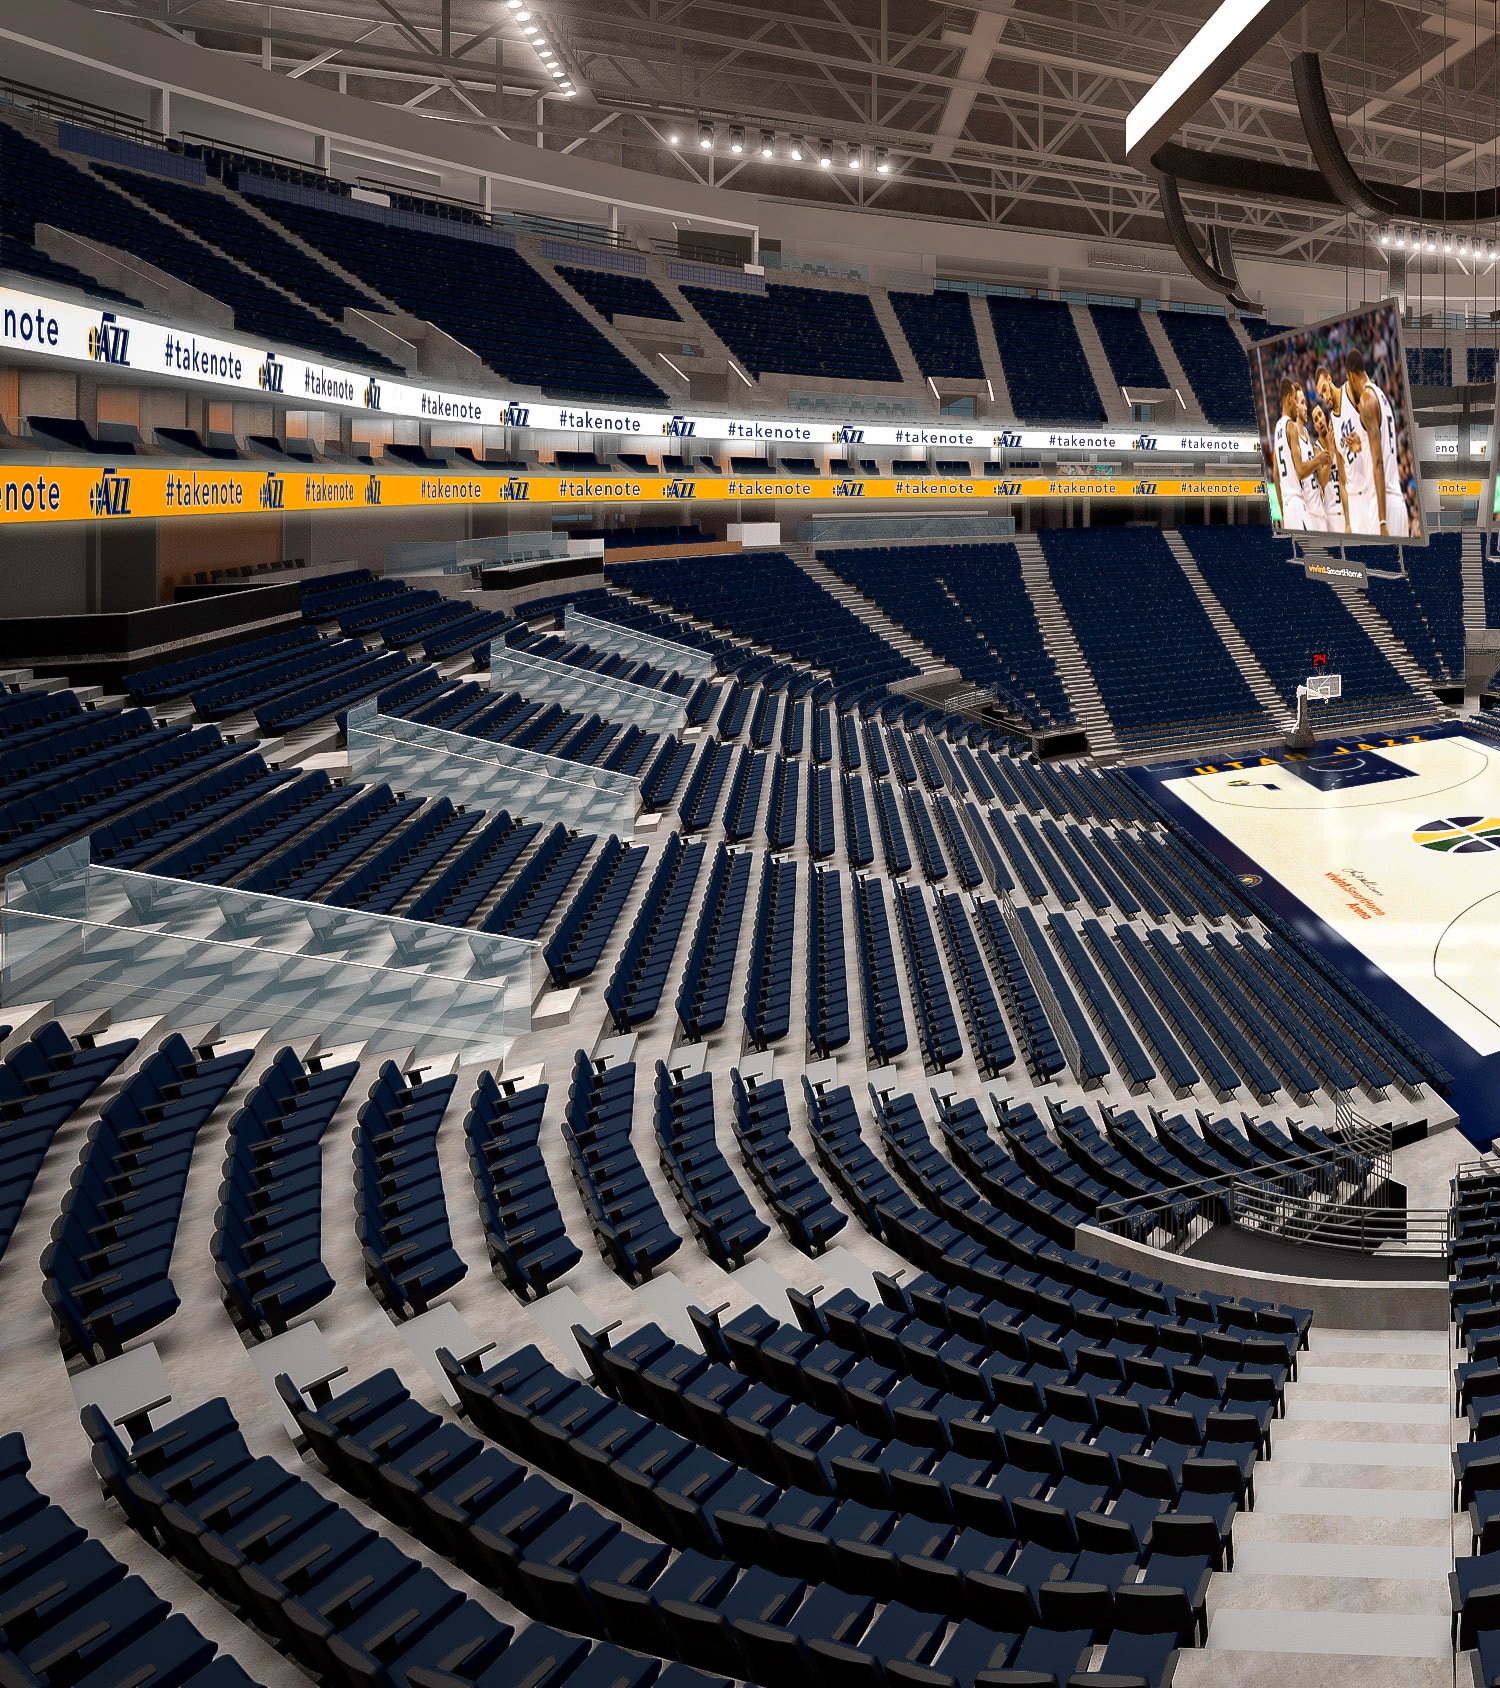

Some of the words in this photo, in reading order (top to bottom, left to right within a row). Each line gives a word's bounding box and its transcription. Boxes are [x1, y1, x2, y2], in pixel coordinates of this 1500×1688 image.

[165, 334, 241, 379] #takenote
[305, 368, 353, 400] #takenote
[422, 392, 482, 419] #takenote
[560, 410, 640, 432] #takenote
[728, 423, 810, 440] #takenote
[896, 430, 973, 444] #takenote
[1050, 435, 1115, 447] #takenote
[1181, 438, 1238, 449] #takenote
[1279, 445, 1287, 477] 5
[165, 472, 243, 506] #takenote
[305, 472, 355, 502] #takenote
[421, 477, 481, 499] #takenote
[559, 479, 641, 497] #takenote
[728, 480, 811, 495] #takenote
[895, 480, 974, 494] #takenote
[1049, 481, 1116, 494] #takenote
[1181, 479, 1240, 493] #takenote
[1313, 654, 1326, 666] 24
[1195, 753, 1308, 775] UTAH
[1333, 735, 1427, 755] JAZZ
